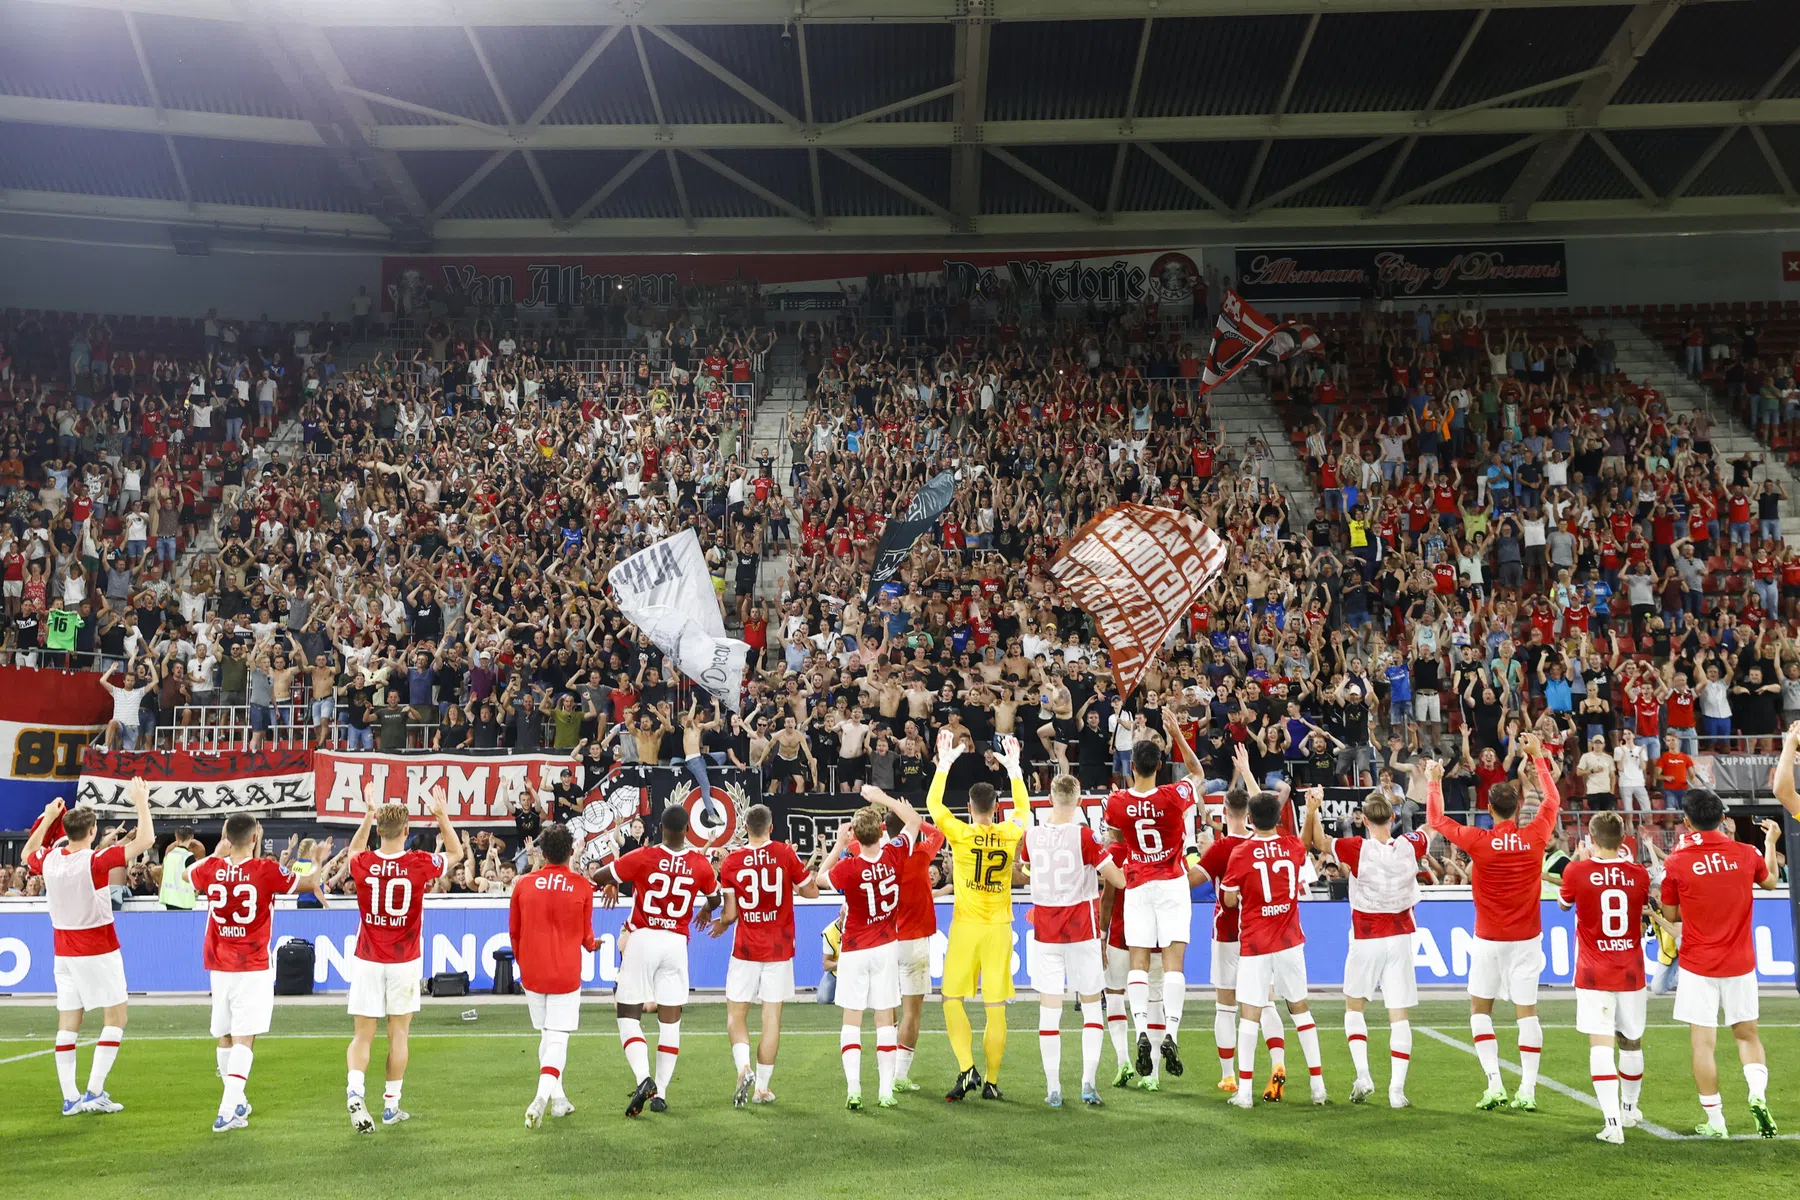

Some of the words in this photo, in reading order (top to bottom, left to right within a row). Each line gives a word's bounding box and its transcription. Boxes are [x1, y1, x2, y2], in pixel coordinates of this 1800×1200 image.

[943, 259, 998, 300] De
[1007, 259, 1146, 301] Victorie
[1374, 251, 1431, 294] City
[1432, 254, 1463, 290] of
[1458, 251, 1561, 281] Dreams
[442, 264, 513, 306] Van
[523, 264, 678, 307] Alkmaar
[53, 617, 68, 633] 16
[1721, 756, 1781, 766] SUPPORTERS
[326, 761, 586, 819] ALKMA
[1126, 800, 1164, 818] elfi.nl
[1134, 818, 1163, 854] 6
[1491, 833, 1531, 851] elfi.nl
[743, 849, 777, 867] elfi.nl
[1253, 841, 1290, 859] elfi.nl
[215, 864, 250, 882] elfi.nl
[369, 859, 408, 877] elfi.nl
[658, 854, 693, 875] elfi.nl
[861, 863, 896, 881] elfi.nl
[970, 848, 1008, 886] 12
[1032, 848, 1076, 891] 22
[1692, 852, 1738, 876] elfi.nl
[535, 873, 574, 893] elfi.nl
[966, 879, 1005, 893] VERHULS
[1252, 859, 1296, 903] 17
[1589, 866, 1635, 886] elfi.nl
[364, 876, 412, 917] 10
[642, 872, 695, 918] 25
[736, 866, 783, 910] 34
[859, 875, 899, 917] 15
[207, 883, 258, 924] 23
[1600, 888, 1629, 937] 8
[374, 915, 387, 926] DE
[389, 915, 408, 927] WIT
[762, 910, 778, 922] WIT
[218, 925, 246, 938] LAHDO
[1597, 938, 1634, 952] CLASIE
